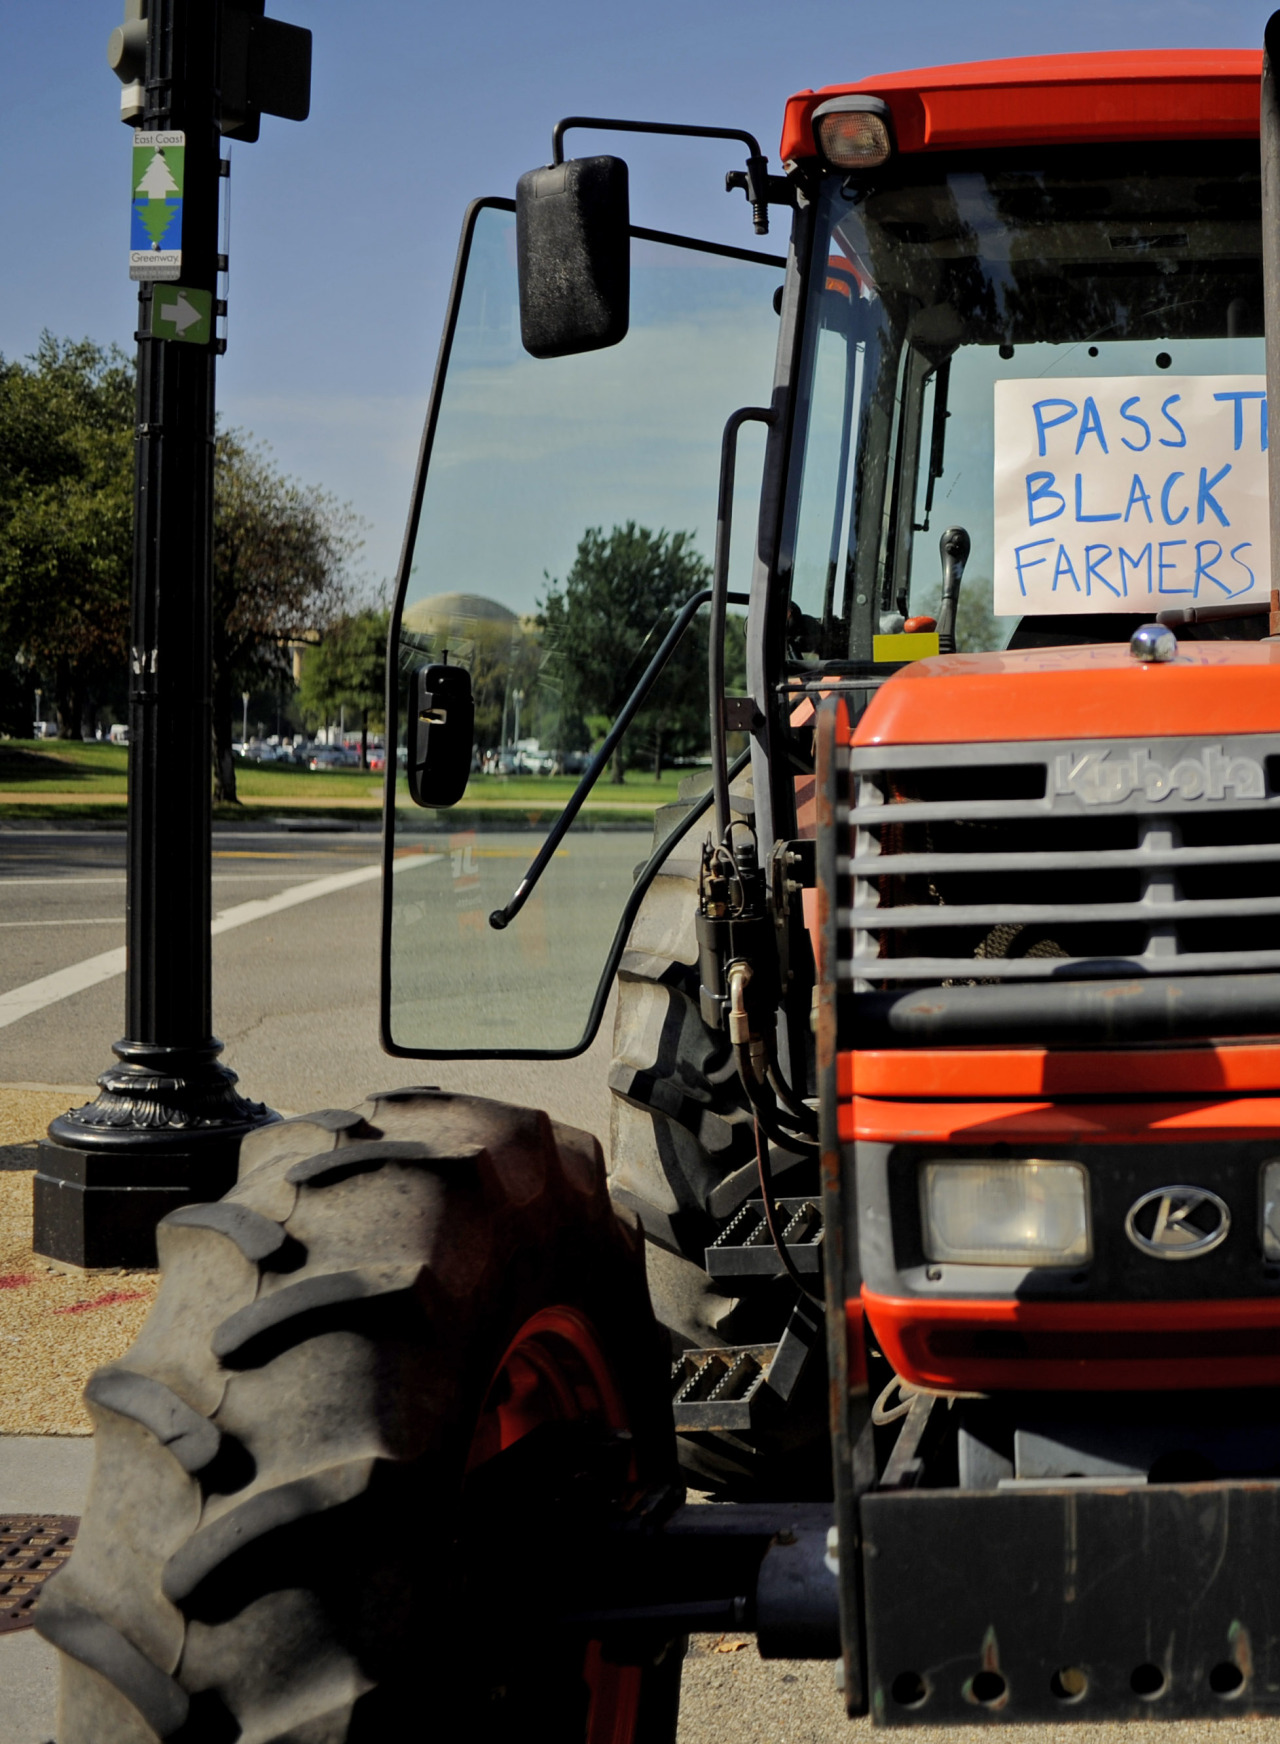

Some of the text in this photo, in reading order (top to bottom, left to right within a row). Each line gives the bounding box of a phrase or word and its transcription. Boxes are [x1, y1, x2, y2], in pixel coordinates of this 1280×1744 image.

[134, 133, 183, 144] East Coast
[1032, 394, 1187, 457] PASS
[1025, 463, 1232, 527] BLACK
[1014, 537, 1255, 600] FARMERS
[1053, 744, 1266, 806] Kubota
